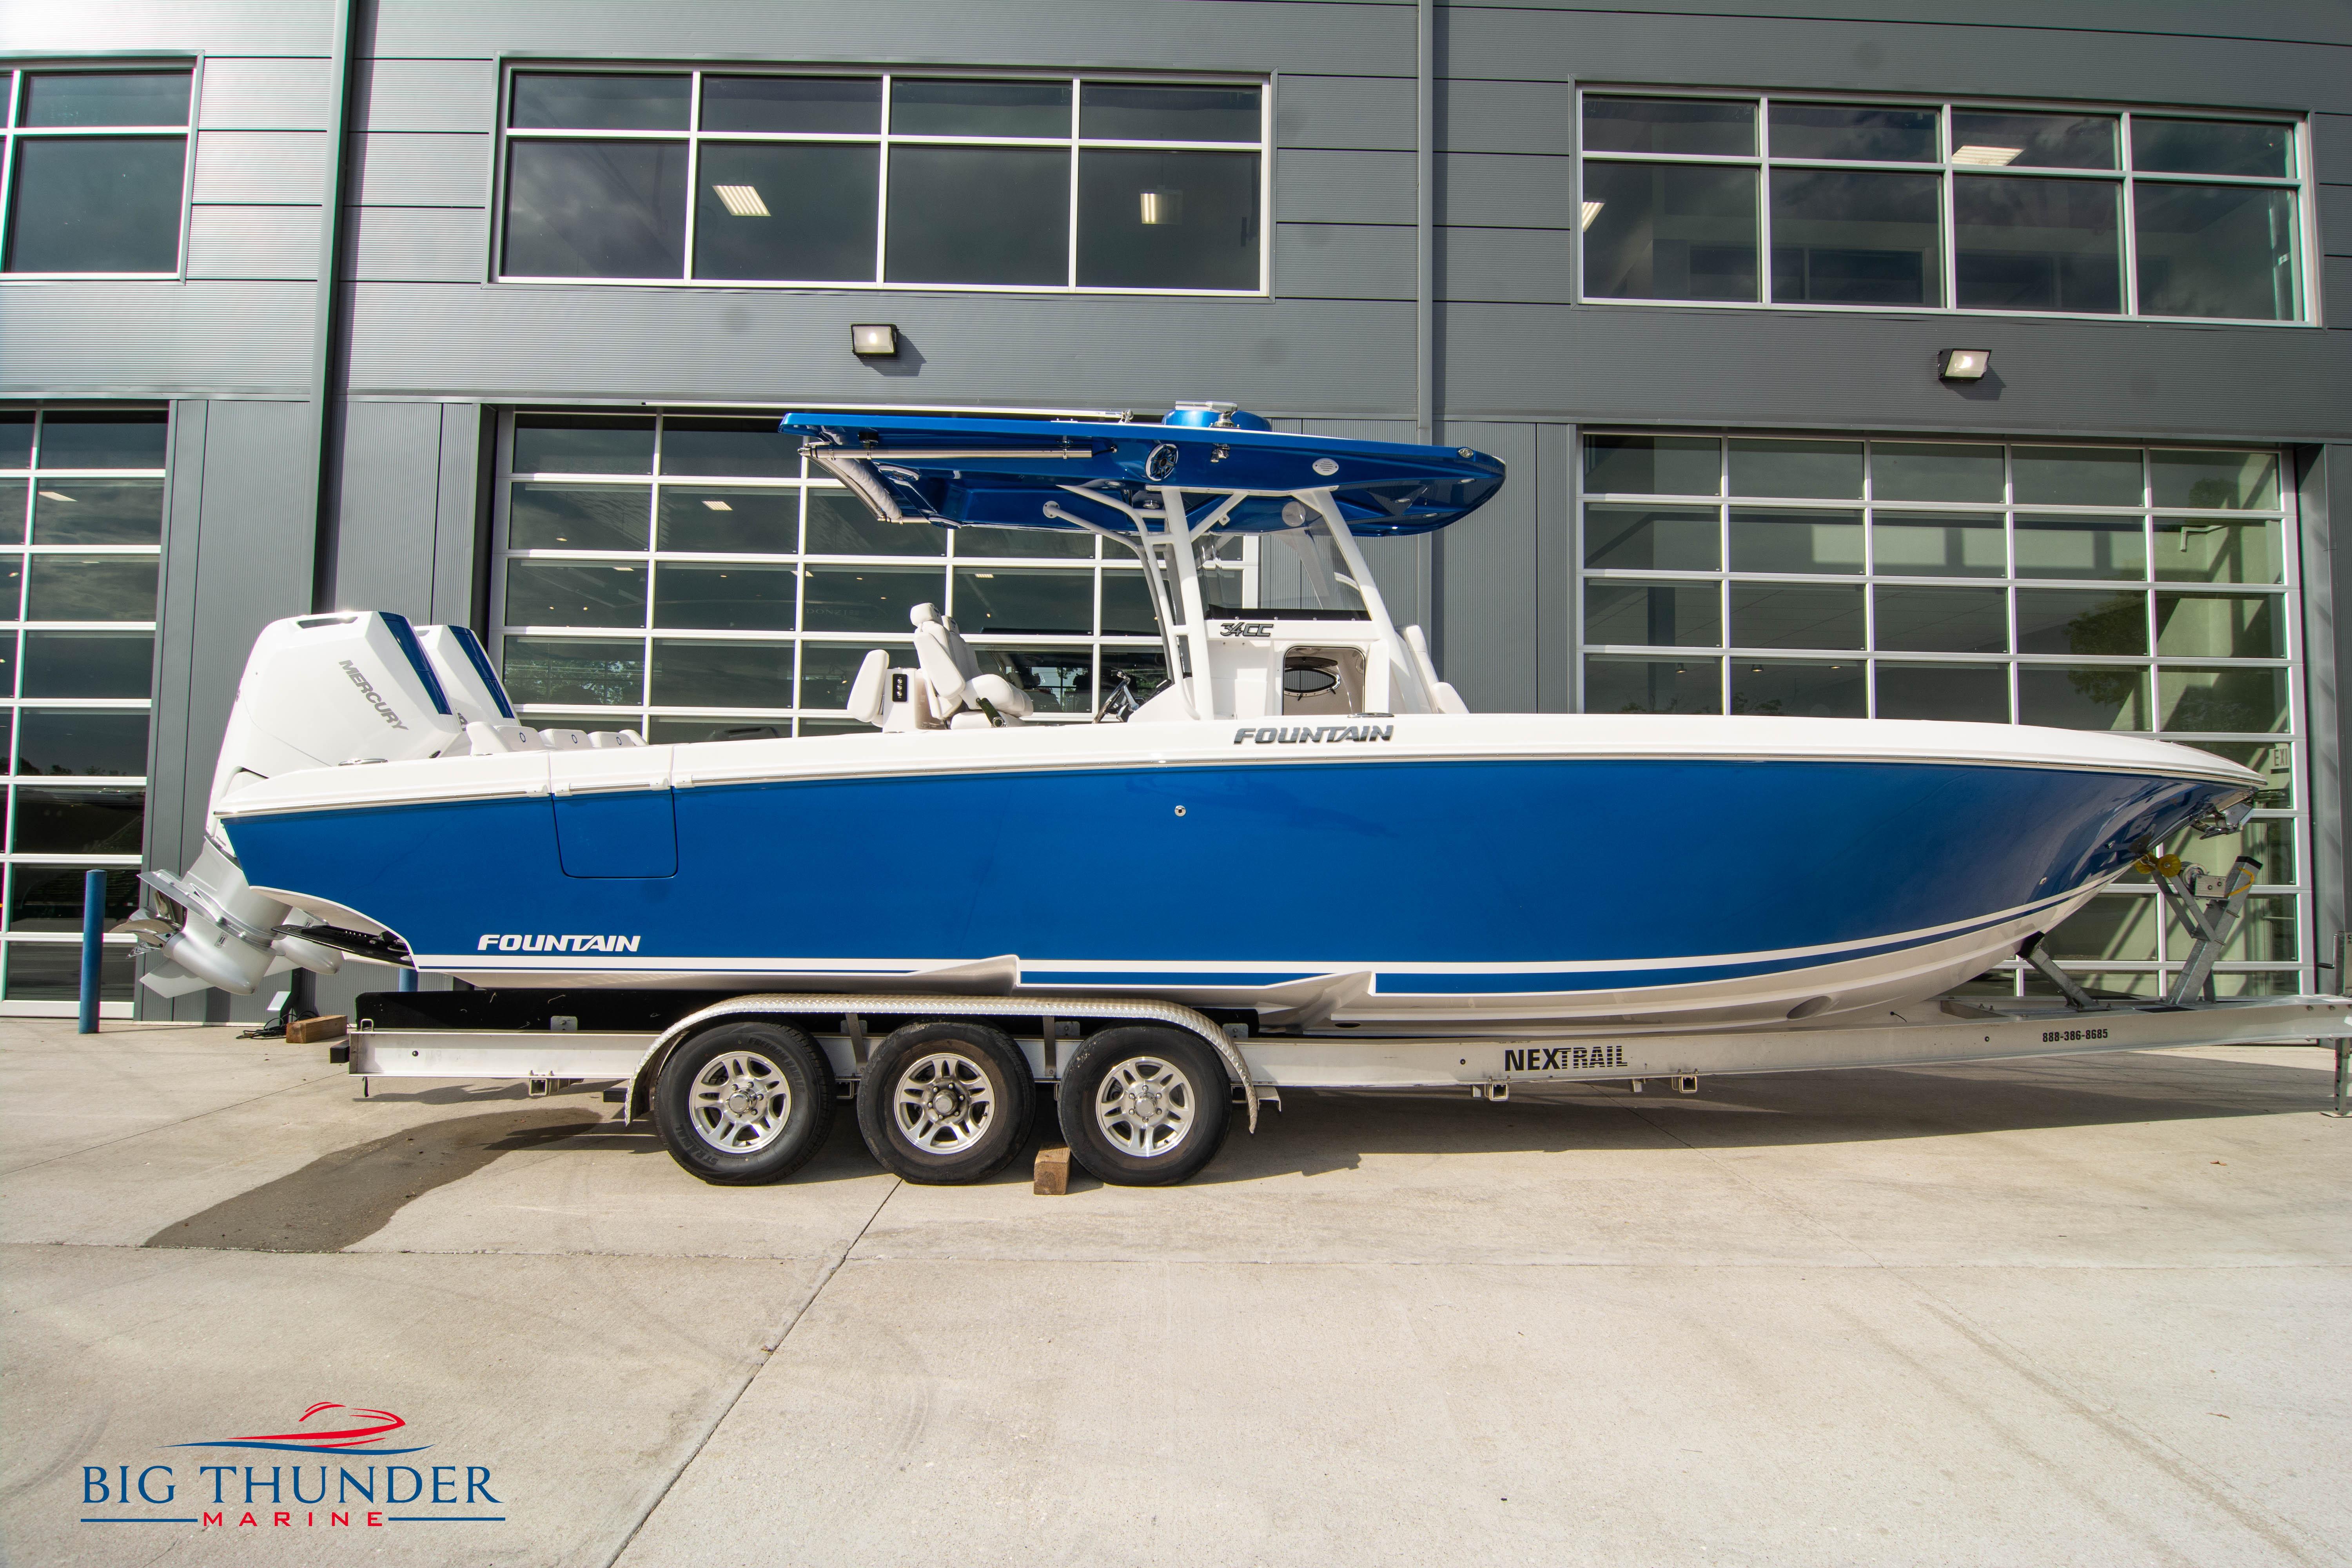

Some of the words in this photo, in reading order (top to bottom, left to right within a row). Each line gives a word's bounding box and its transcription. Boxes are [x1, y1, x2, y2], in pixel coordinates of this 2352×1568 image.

[1220, 622, 1274, 637] 34CC
[339, 660, 409, 730] MERCURY
[1233, 725, 1394, 744] FOUNTAIN
[2274, 749, 2290, 766] EXI
[477, 935, 641, 952] FOUNTAIN
[2043, 1029, 2108, 1042] 888-386-8685
[1505, 1045, 1628, 1071] NEXTRAIL
[675, 1123, 707, 1160] RADIAL
